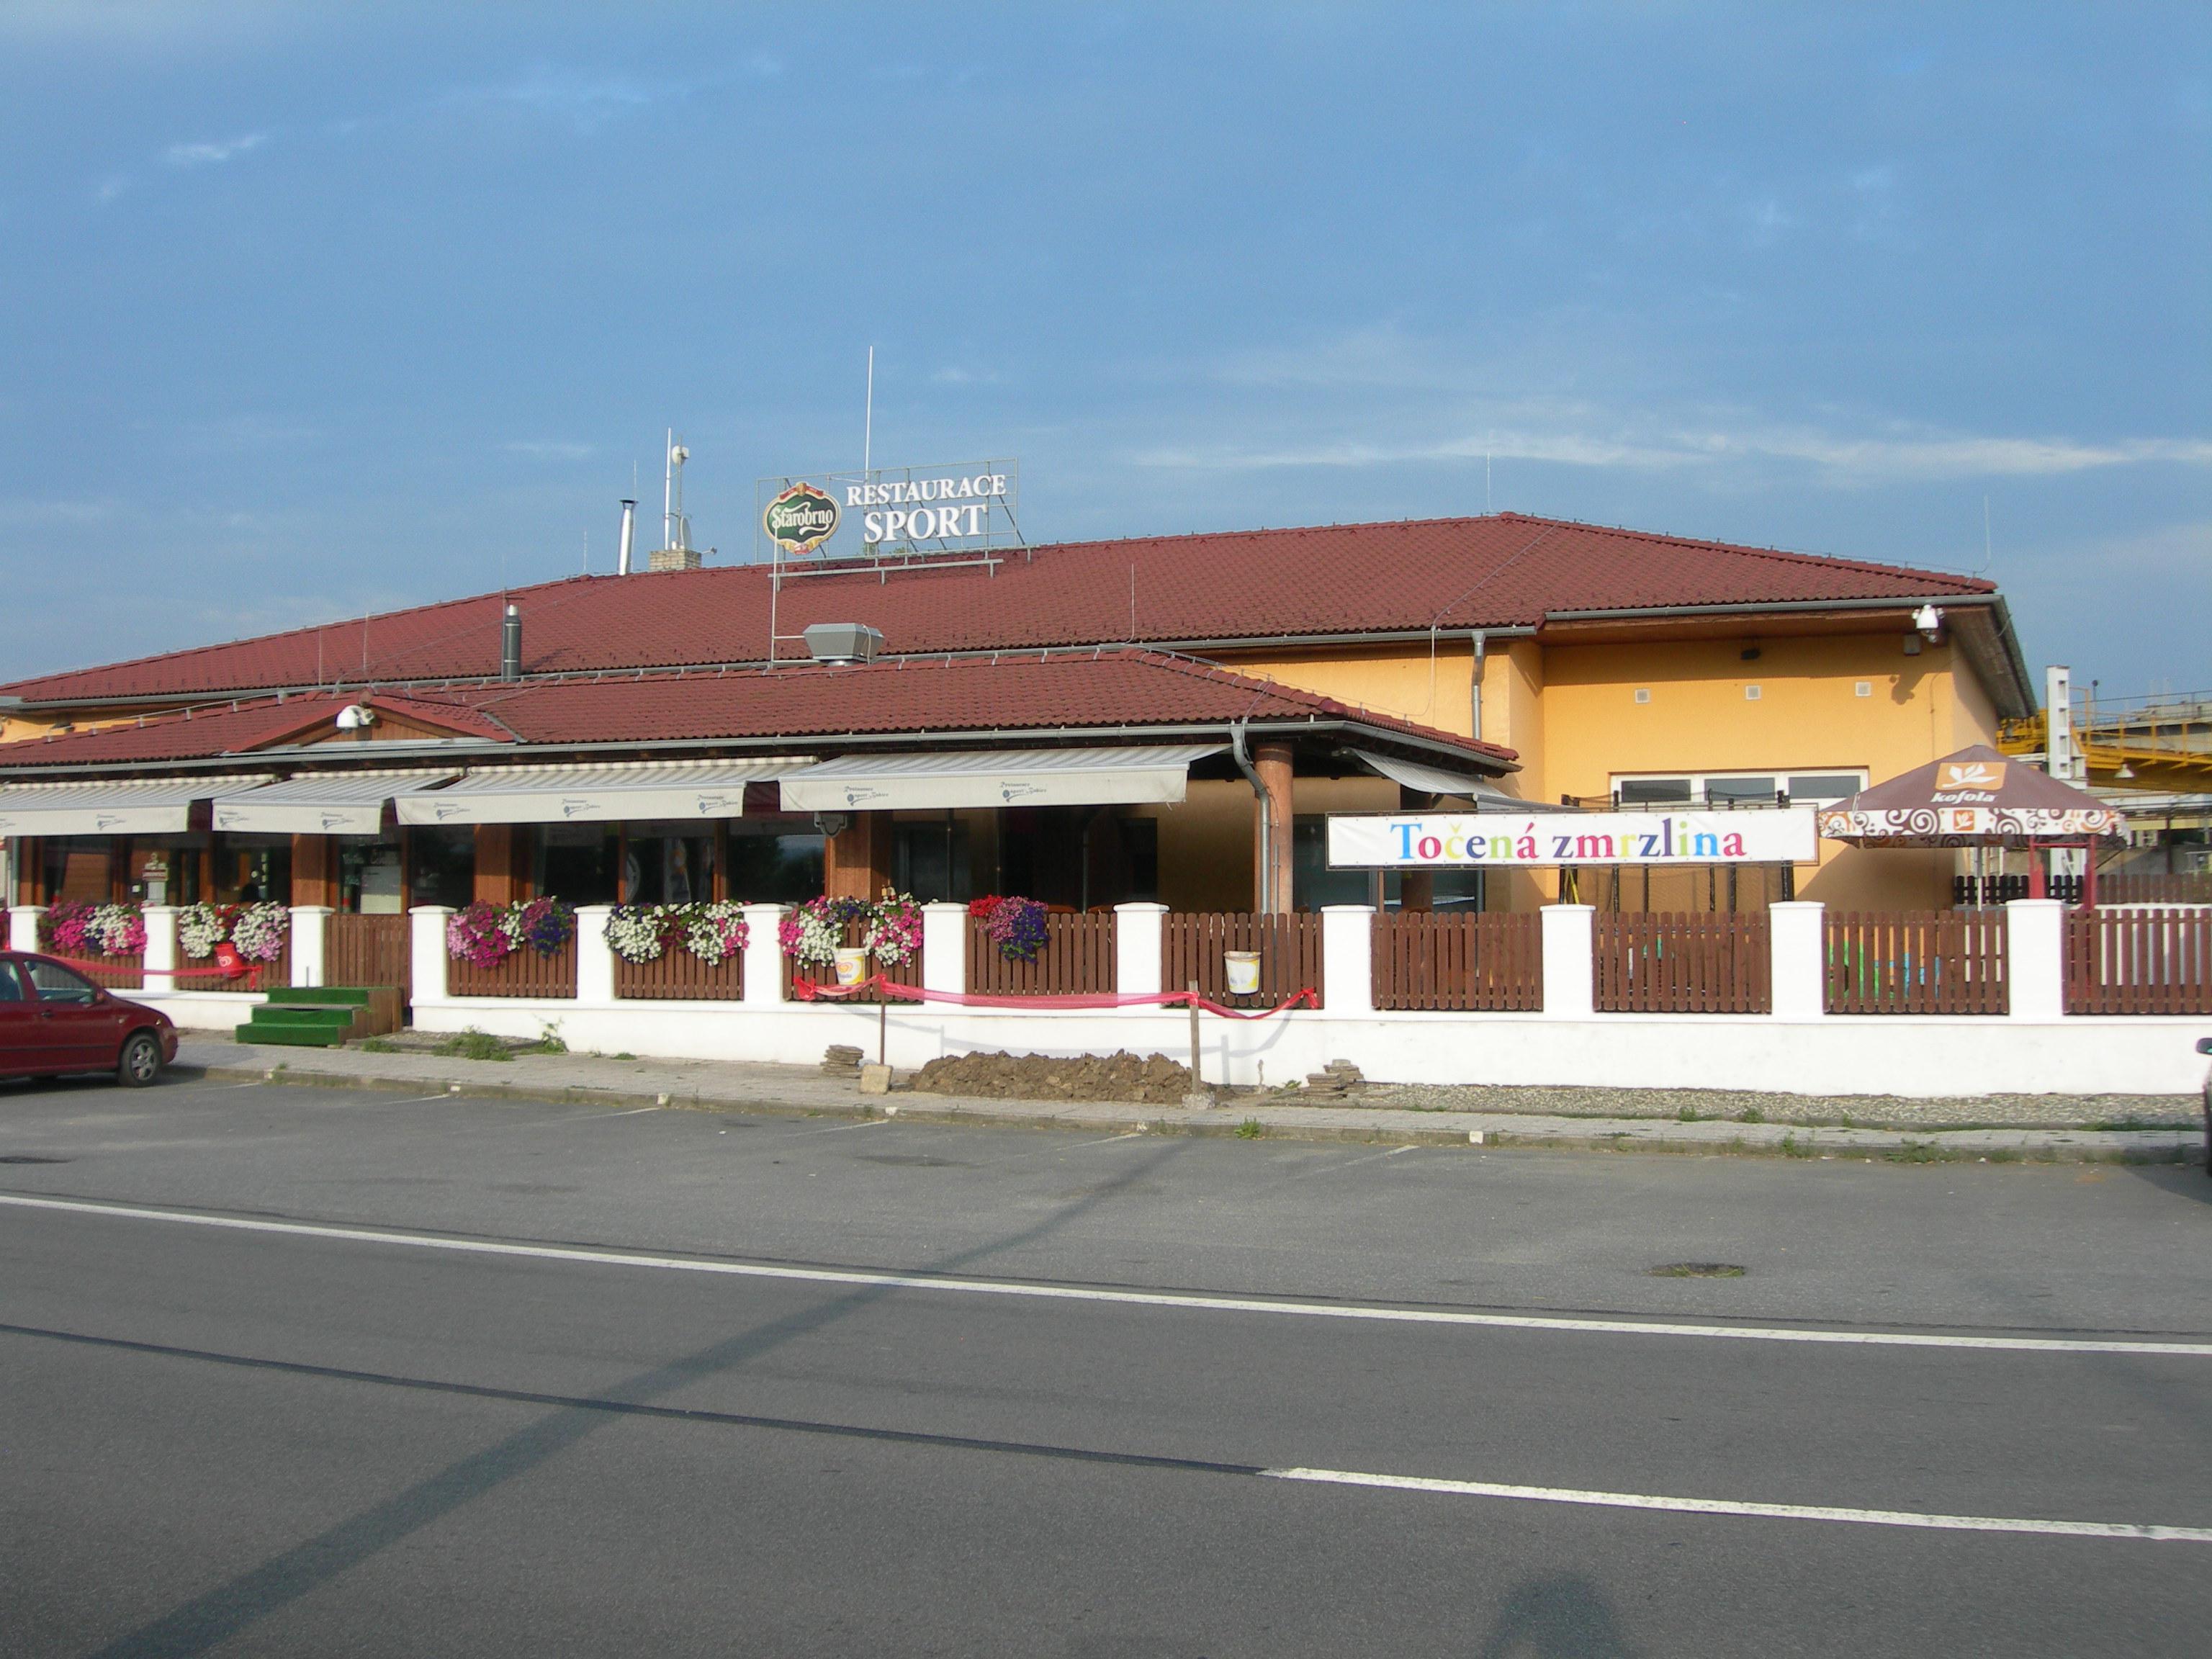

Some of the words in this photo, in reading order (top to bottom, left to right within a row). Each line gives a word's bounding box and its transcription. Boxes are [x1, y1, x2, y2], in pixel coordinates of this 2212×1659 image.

[846, 475, 1007, 507] RESTAURACE
[771, 501, 834, 536] Starobrno
[864, 503, 988, 544] SPORT
[1930, 791, 1999, 805] kofola
[1390, 822, 1540, 860] Točená
[1552, 817, 1748, 859] zmrzlina
